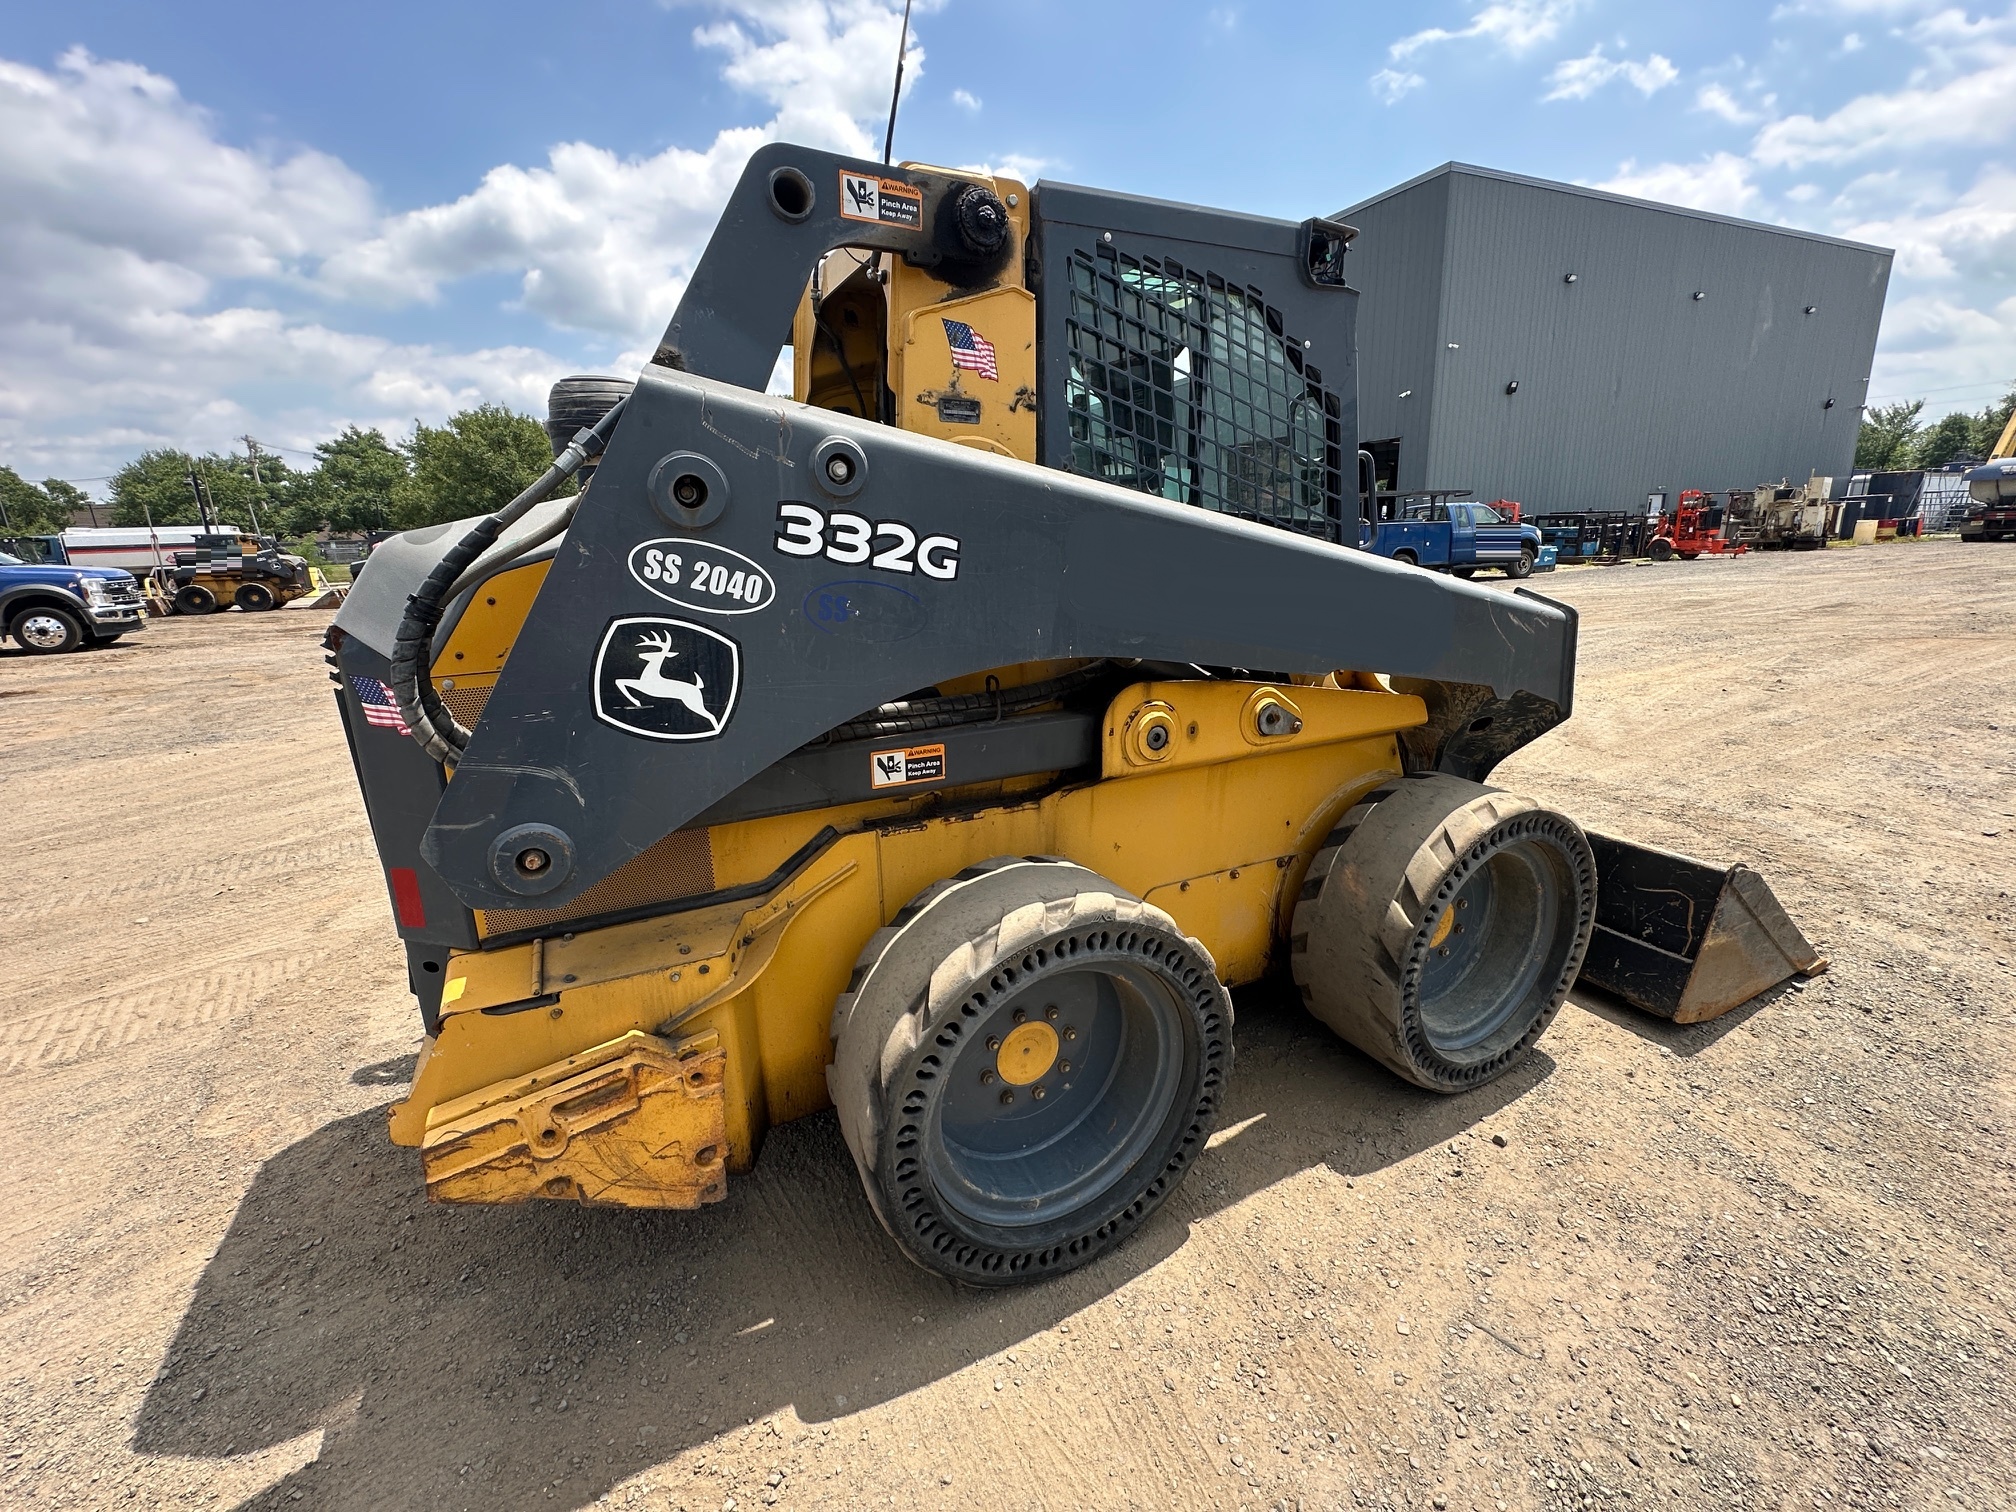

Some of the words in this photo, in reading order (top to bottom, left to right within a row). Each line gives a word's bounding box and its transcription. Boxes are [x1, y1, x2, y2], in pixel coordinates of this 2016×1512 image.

[888, 184, 919, 196] WARNING
[881, 198, 900, 209] Pinch
[901, 202, 918, 212] Area
[881, 208, 897, 218] Keep
[897, 211, 913, 221] Away
[775, 502, 960, 581] 332G
[643, 549, 682, 585] SS
[690, 561, 763, 604] 2040
[914, 747, 941, 757] WARNING
[907, 762, 925, 770] Pinch
[926, 760, 941, 768] Area
